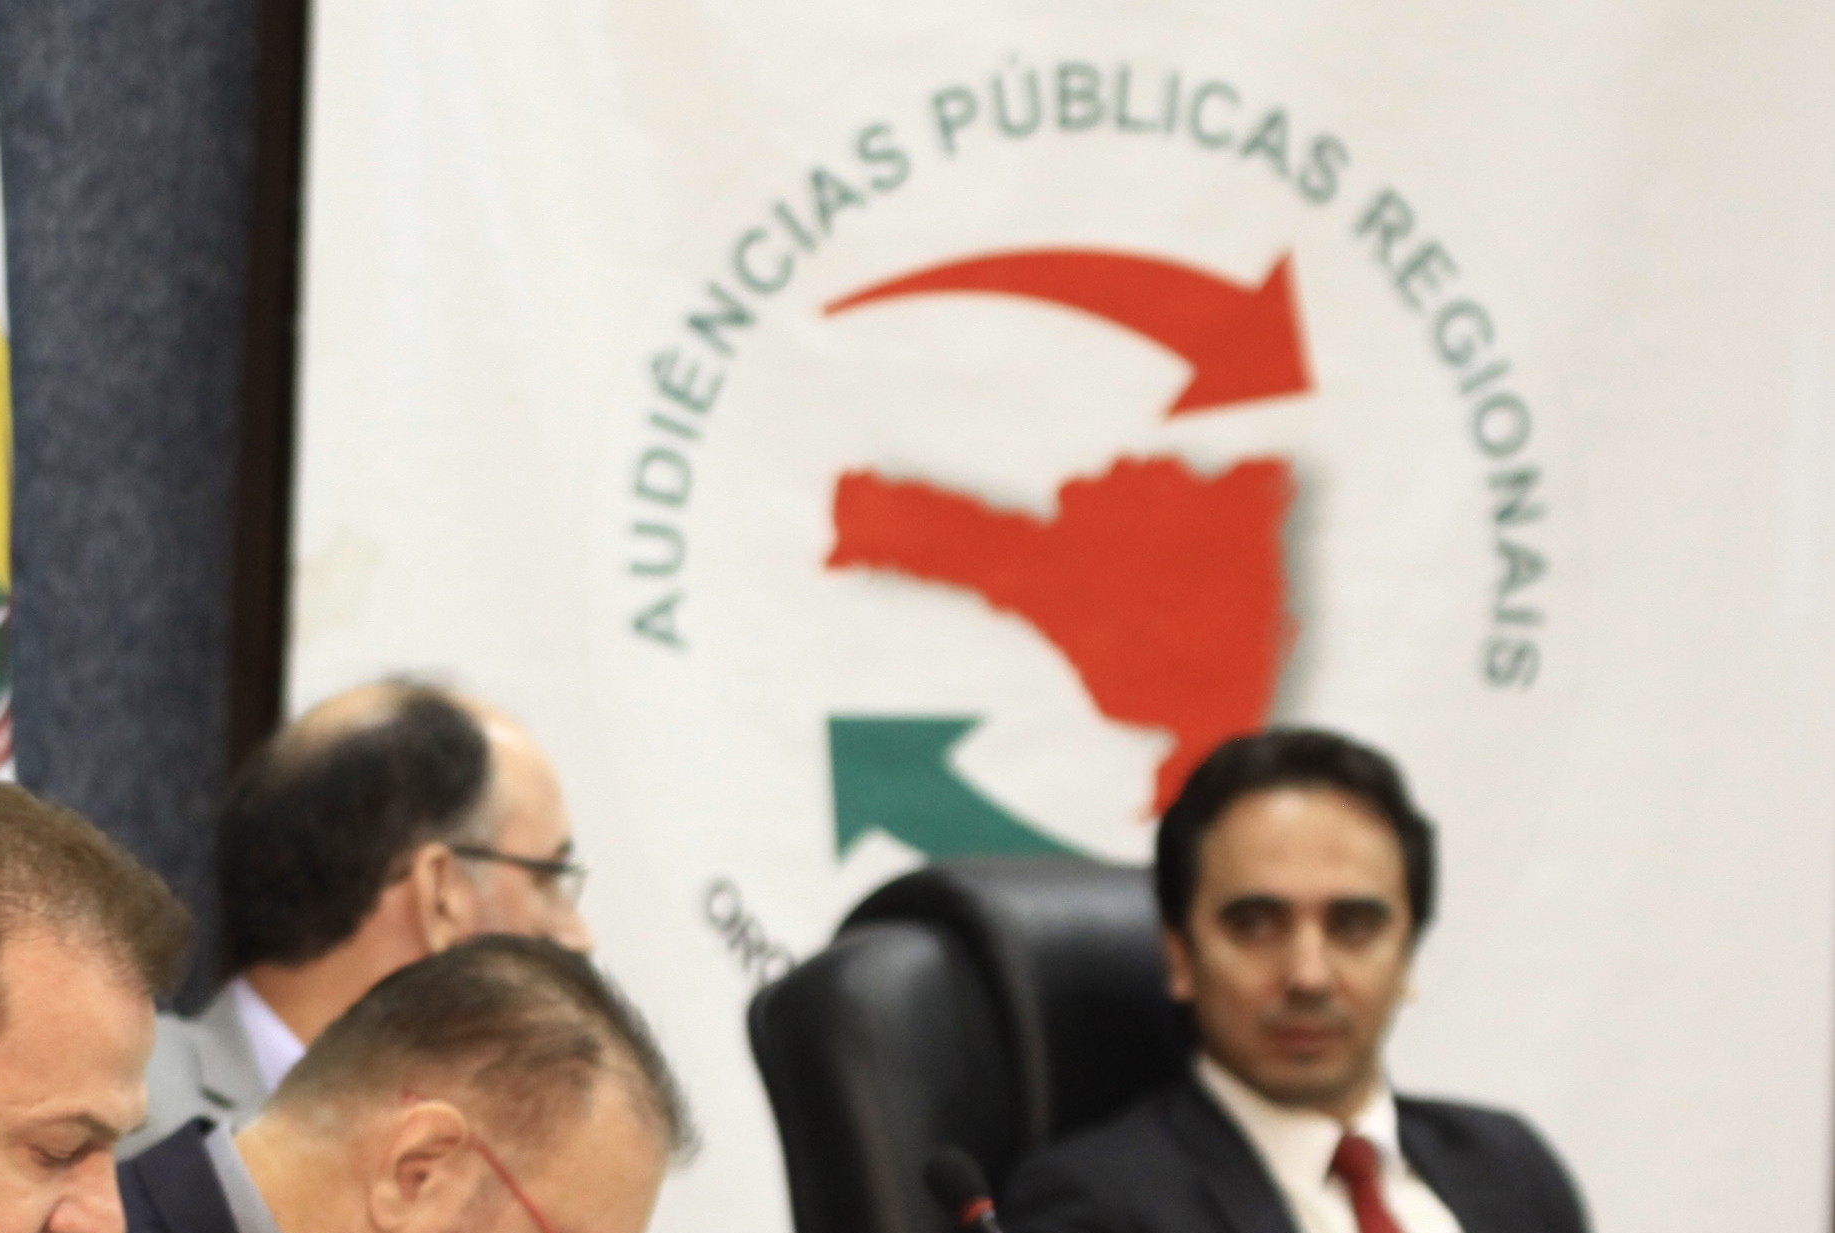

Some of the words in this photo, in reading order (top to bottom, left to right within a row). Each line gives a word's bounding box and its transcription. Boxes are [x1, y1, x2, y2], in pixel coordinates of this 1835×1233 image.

[628, 122, 912, 655] AUDIÊNCIAS
[931, 56, 1351, 206] PÚBLICAS
[1350, 188, 1549, 690] REGIONAIS
